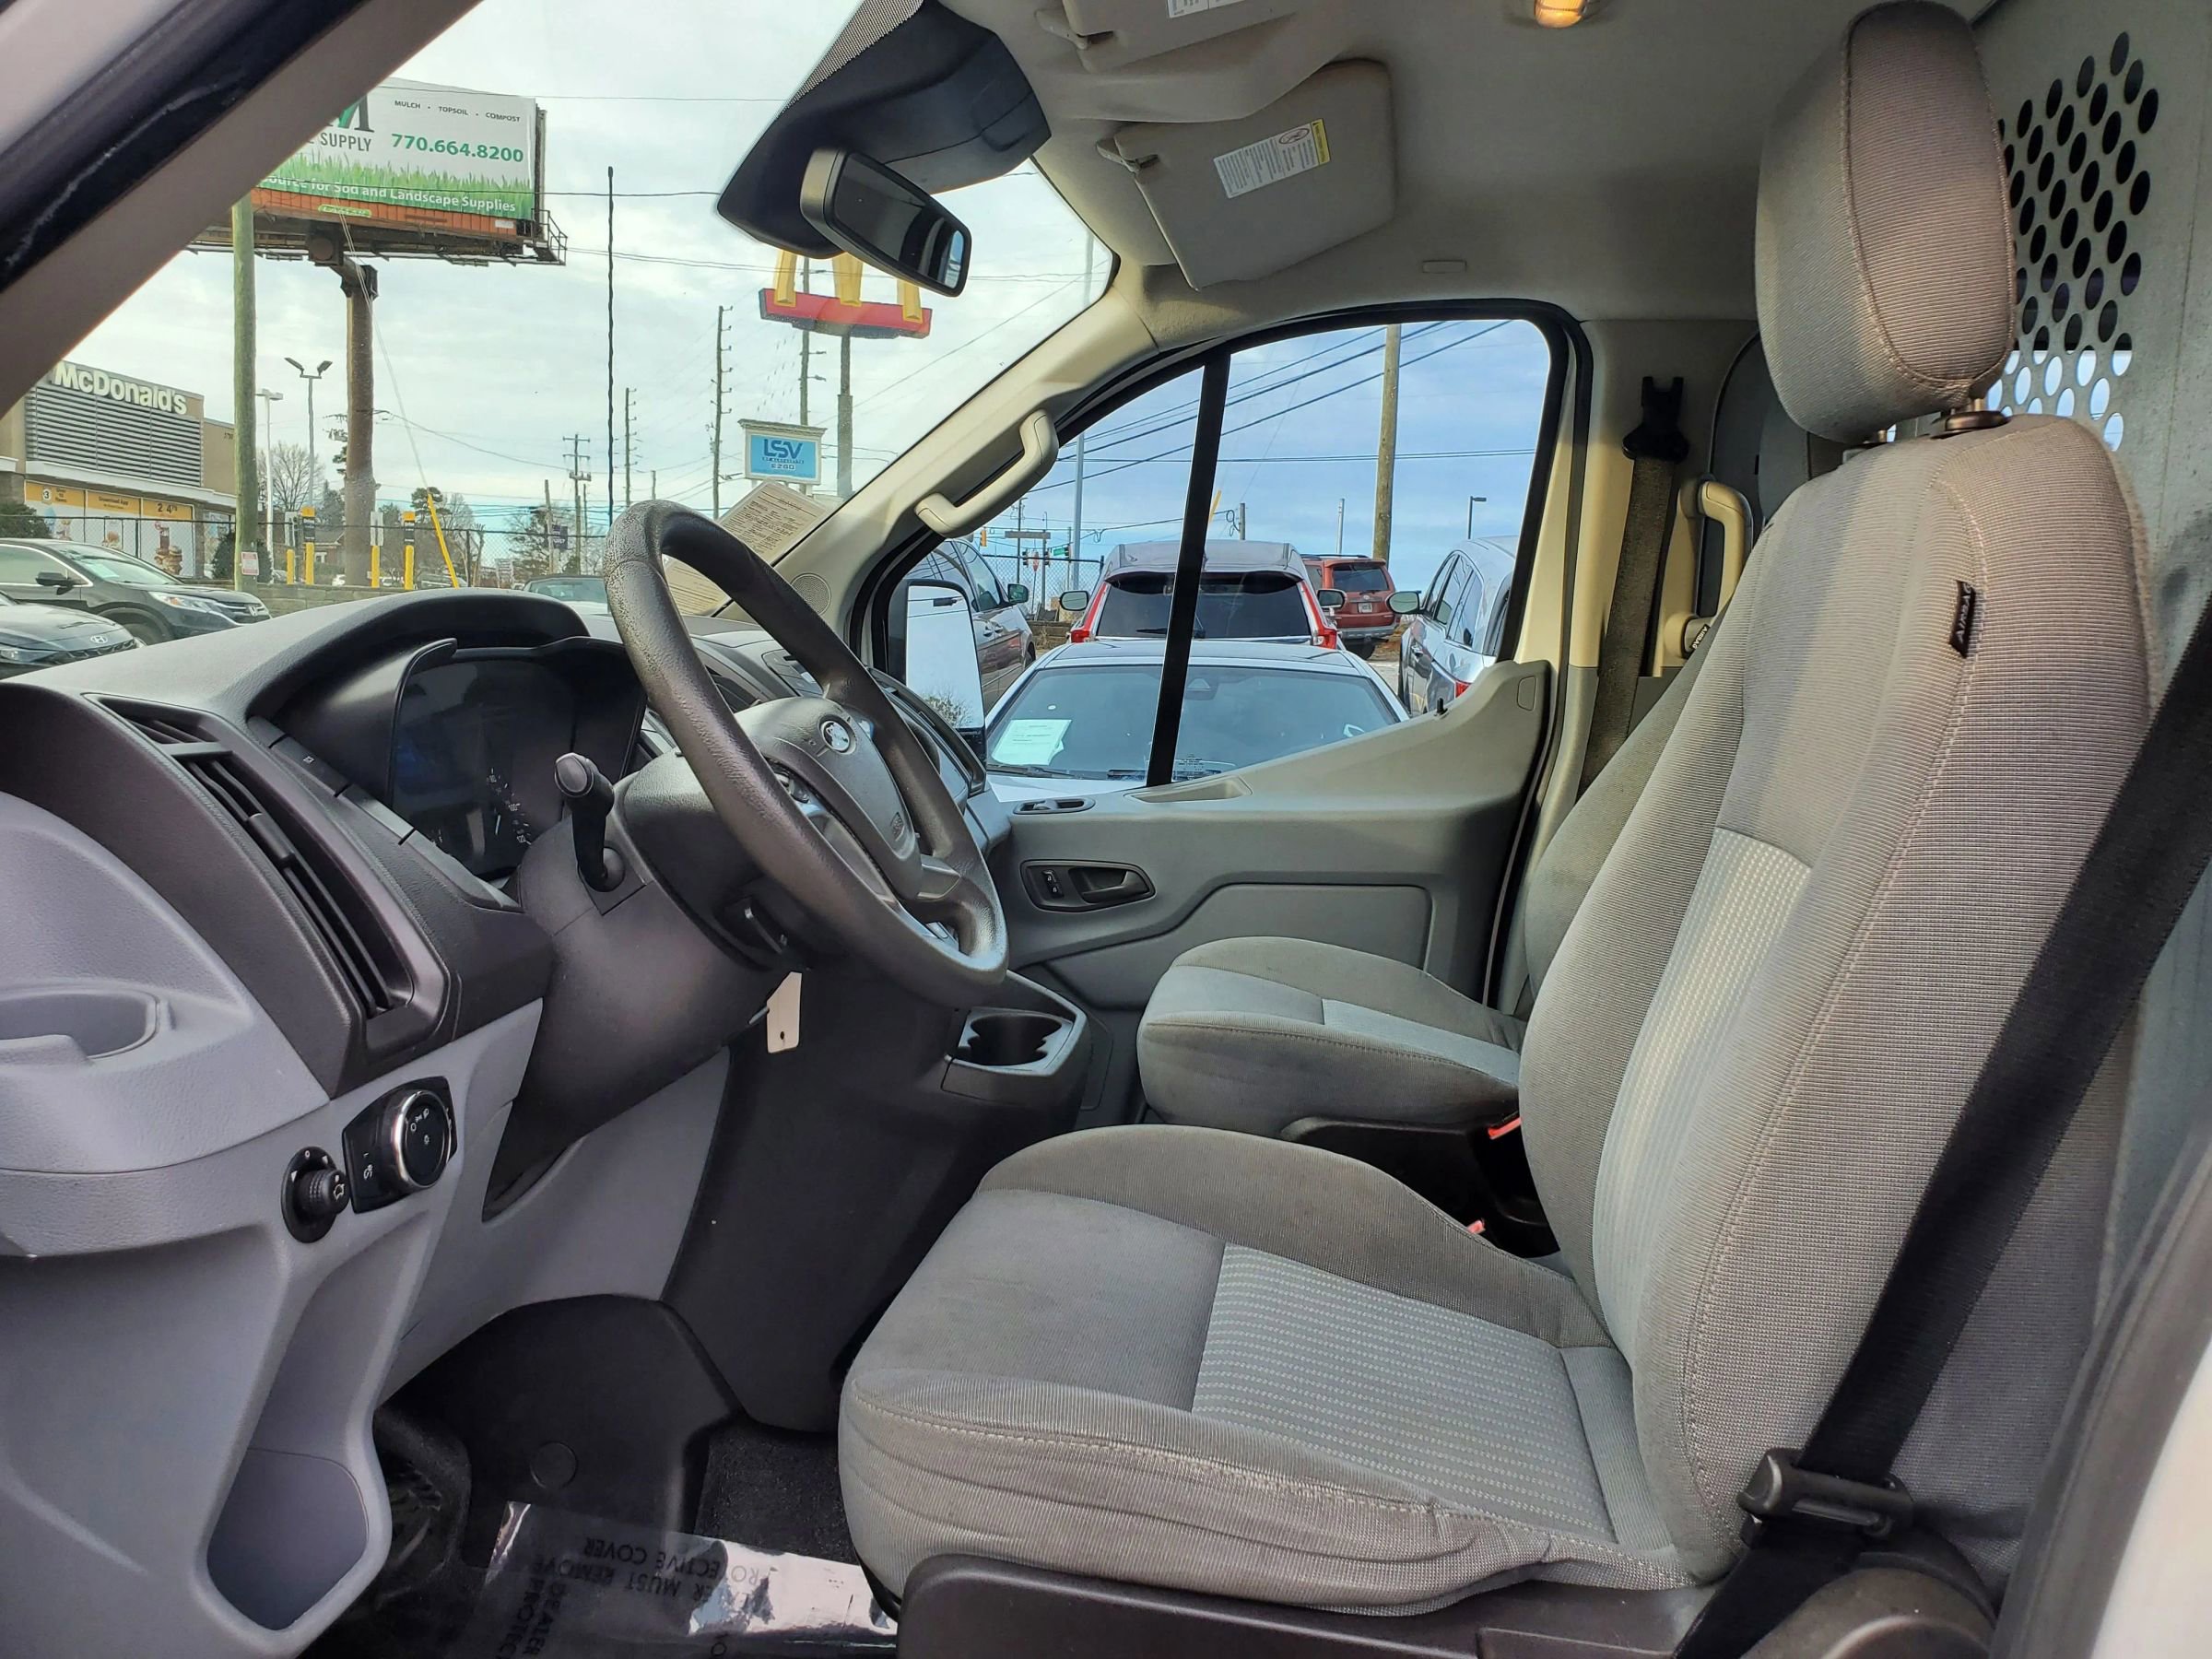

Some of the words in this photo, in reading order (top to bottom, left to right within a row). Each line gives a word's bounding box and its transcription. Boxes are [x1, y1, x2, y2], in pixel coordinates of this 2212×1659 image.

[394, 100, 421, 110] MULCH
[438, 106, 469, 116] TOPSOIL
[485, 112, 521, 123] COMPOST
[320, 132, 372, 152] SUPPLY
[392, 133, 524, 162] 770.664.8200
[262, 175, 307, 188] ource
[311, 178, 329, 192] for
[334, 182, 359, 195] Sod
[362, 185, 387, 198] and
[390, 187, 460, 207] Landscape
[461, 195, 516, 212] Supplies
[53, 360, 187, 415] McDonald's
[763, 438, 803, 459] LSV
[583, 1536, 647, 1566] COVER
[624, 1571, 682, 1597] MUST
[495, 1577, 546, 1659] PROTEC
